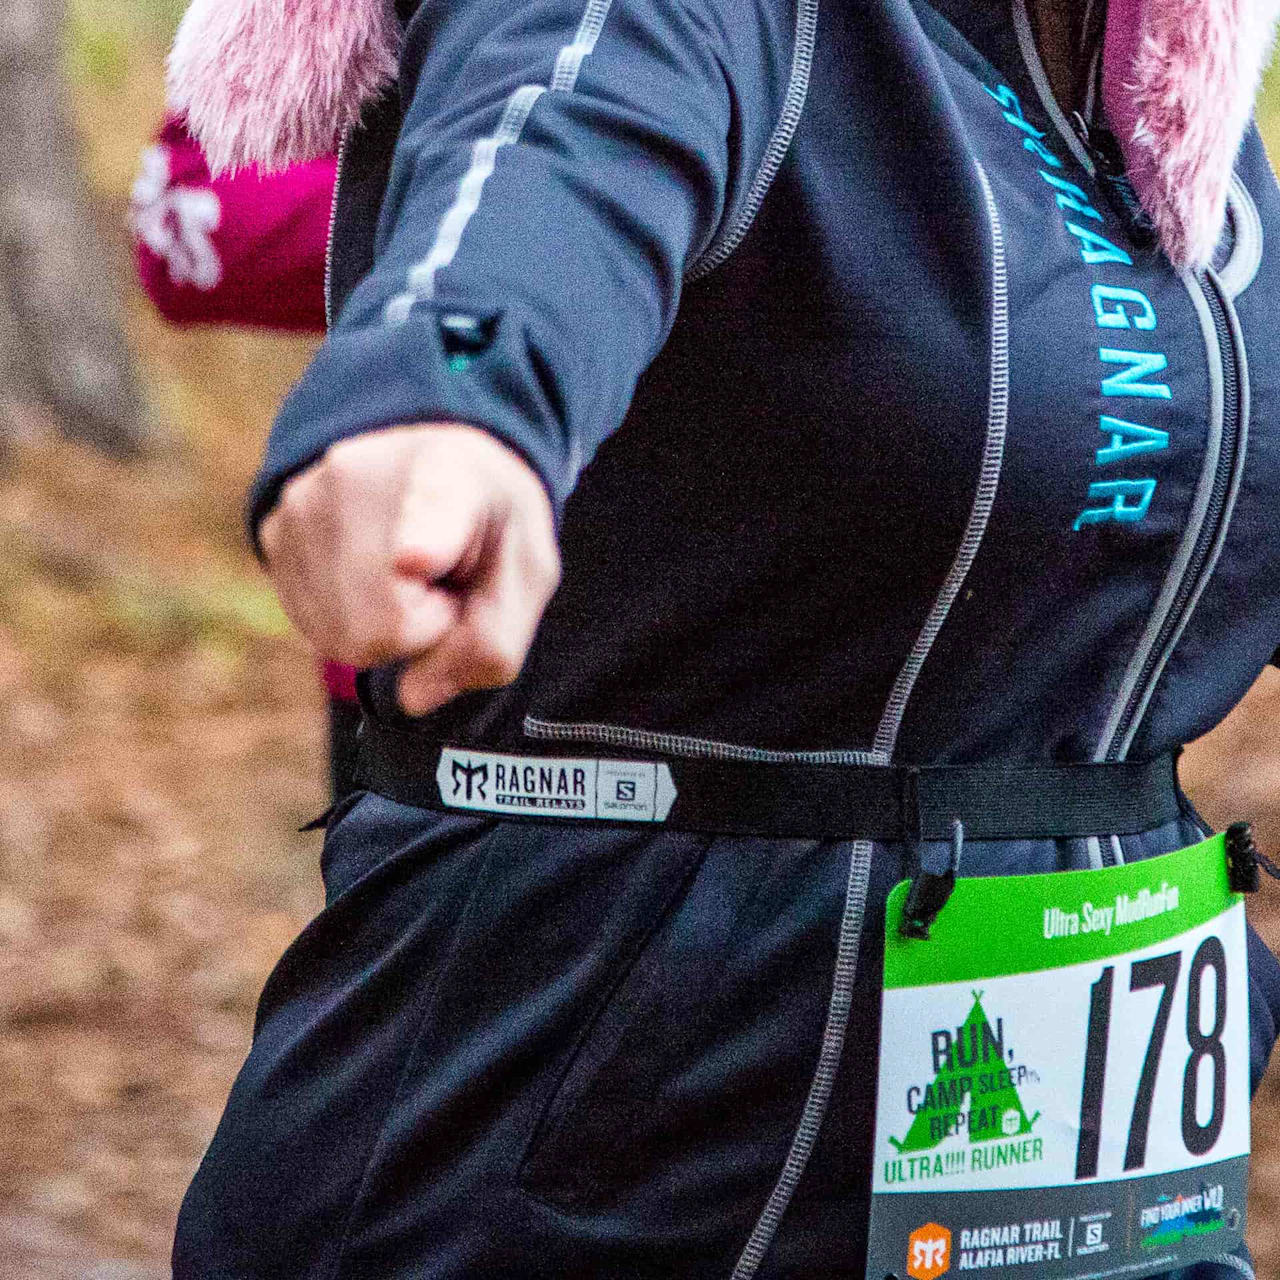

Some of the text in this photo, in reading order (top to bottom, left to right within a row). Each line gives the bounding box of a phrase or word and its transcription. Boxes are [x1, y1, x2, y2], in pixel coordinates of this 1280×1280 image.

[495, 763, 586, 797] RAGNAR
[496, 793, 532, 807] TRAIL
[1043, 906, 1080, 940] Ultra
[1081, 900, 1114, 937] Sexy
[1074, 935, 1228, 1181] 178
[907, 1077, 973, 1116] CAMP
[929, 1105, 1001, 1141] REPEAT
[883, 1137, 1044, 1185] ULTRA!!!! RUNNER
[960, 1220, 1064, 1250] RAGNAR TRAIL
[959, 1246, 1006, 1271] ALAFIA
[1006, 1240, 1063, 1266] RIVER-FL
